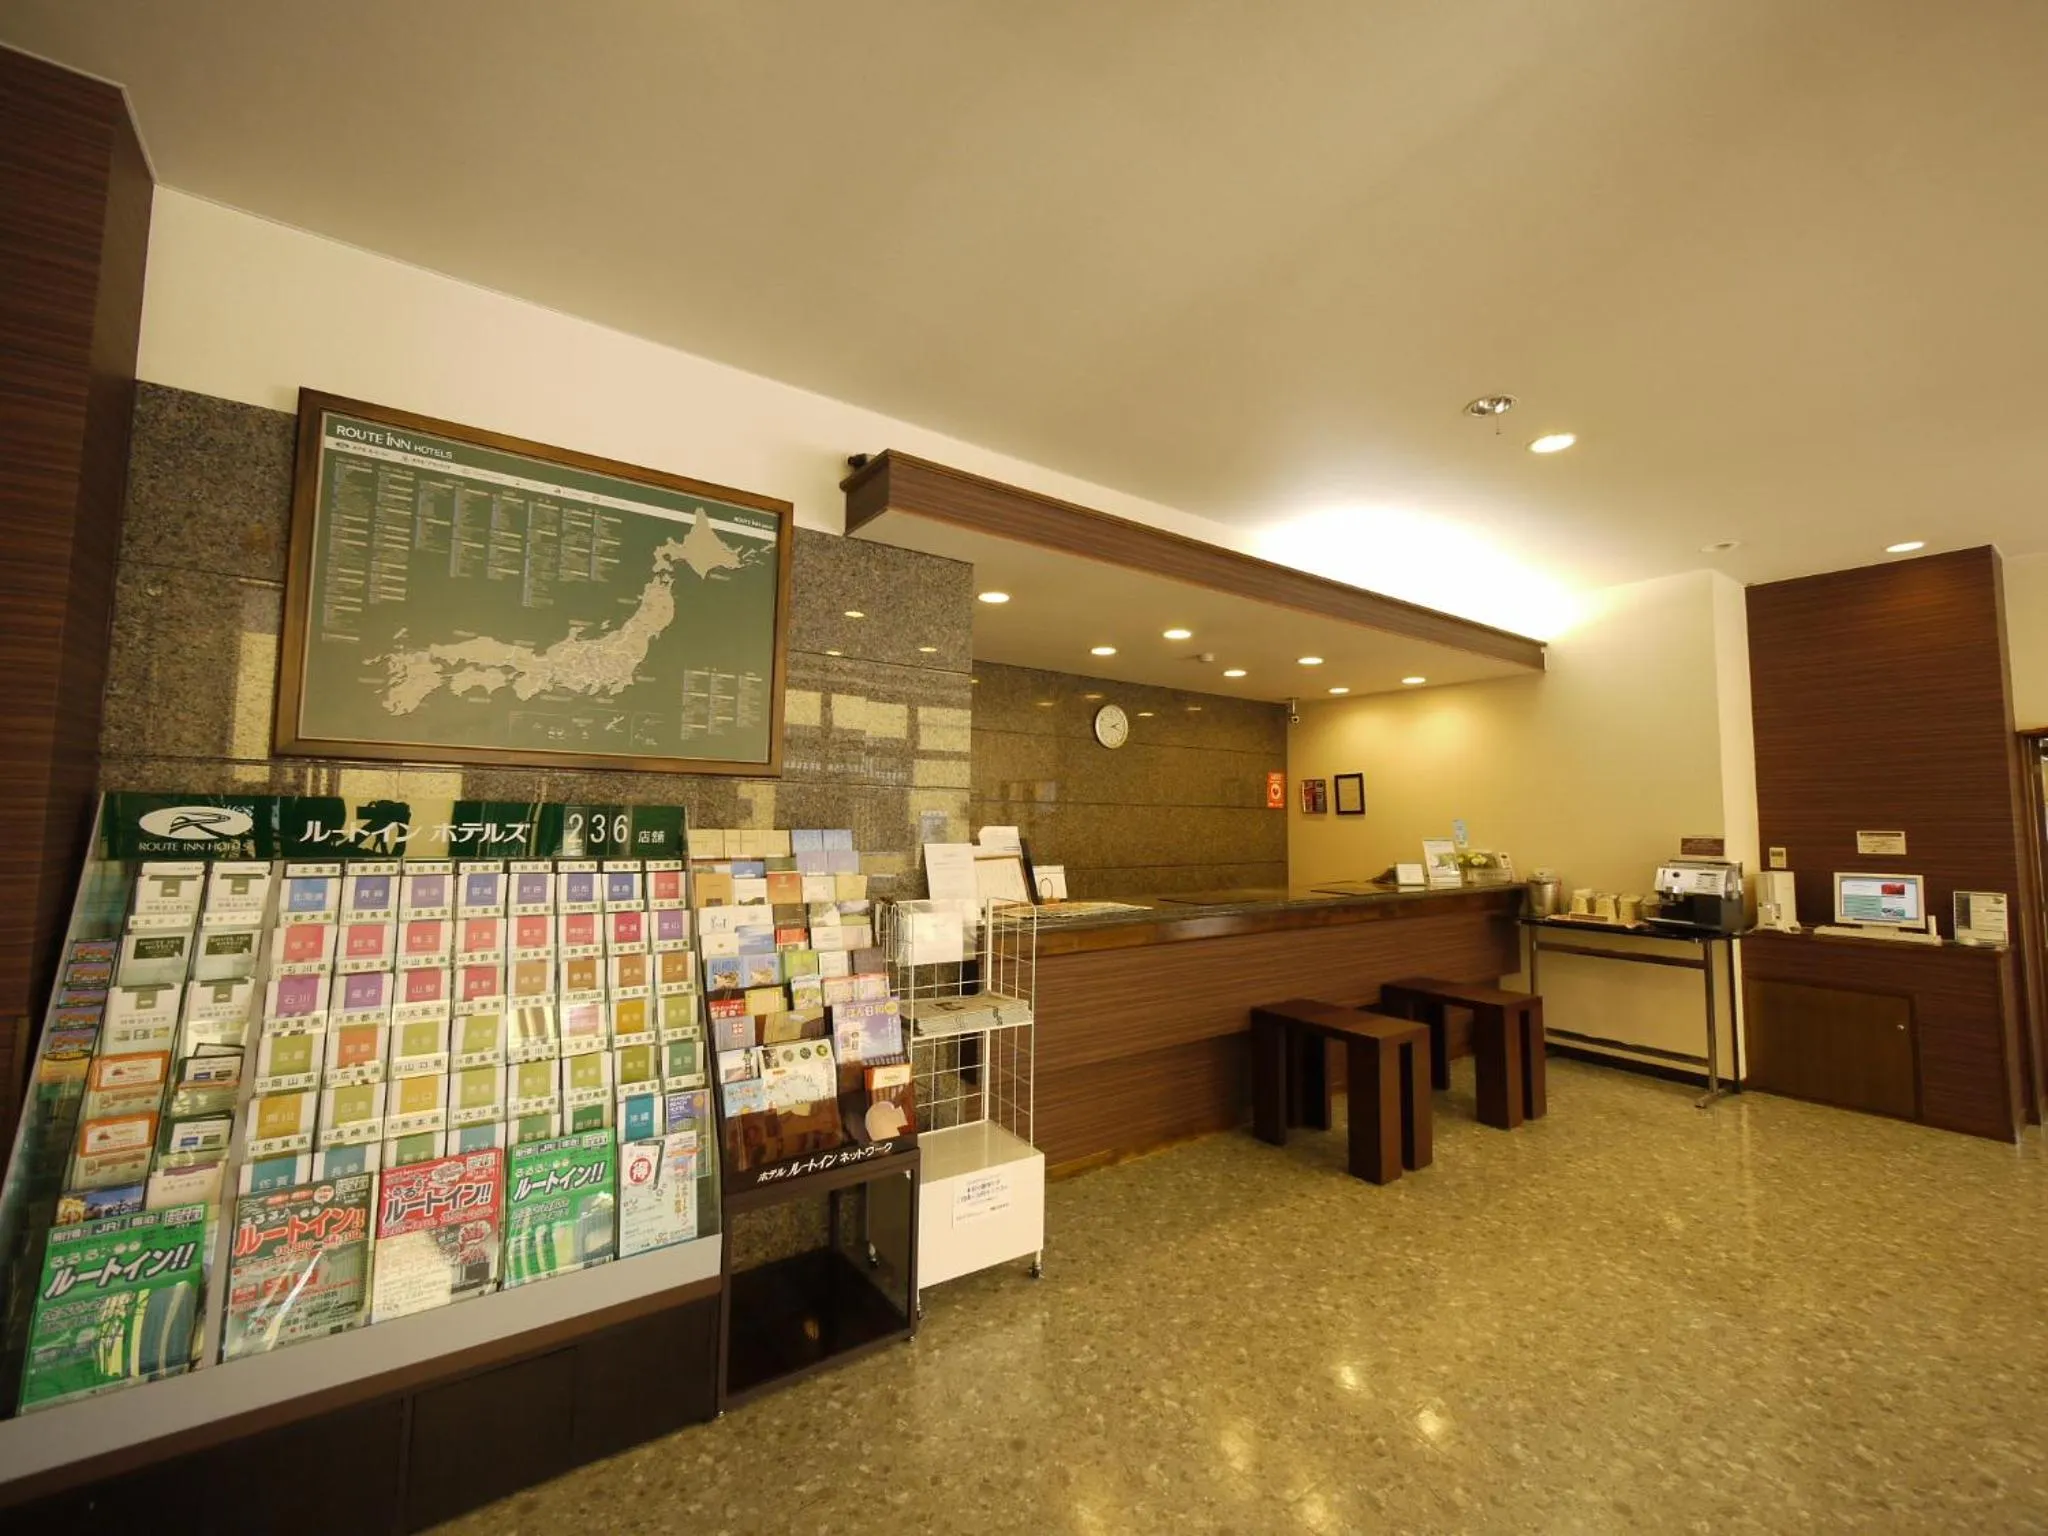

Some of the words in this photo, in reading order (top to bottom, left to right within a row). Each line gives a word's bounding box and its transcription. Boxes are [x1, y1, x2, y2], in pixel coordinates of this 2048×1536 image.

[336, 425, 383, 444] ROUTE
[414, 445, 452, 459] HOTELS
[138, 841, 179, 853] ROUTE
[183, 841, 205, 852] INN
[300, 819, 422, 846] ルートイン
[430, 822, 530, 844] ホテルズ
[567, 813, 629, 844] 236
[638, 830, 665, 844] 店舗
[513, 1161, 607, 1201] ルートイン!!
[757, 1168, 786, 1183] ホテル
[787, 1153, 838, 1178] ルートイン
[839, 1142, 894, 1163] ネットワーク
[383, 1182, 493, 1226] ルートイン!!
[235, 1207, 366, 1257] ルートイン!!
[43, 1243, 196, 1299] ルートイン!!
